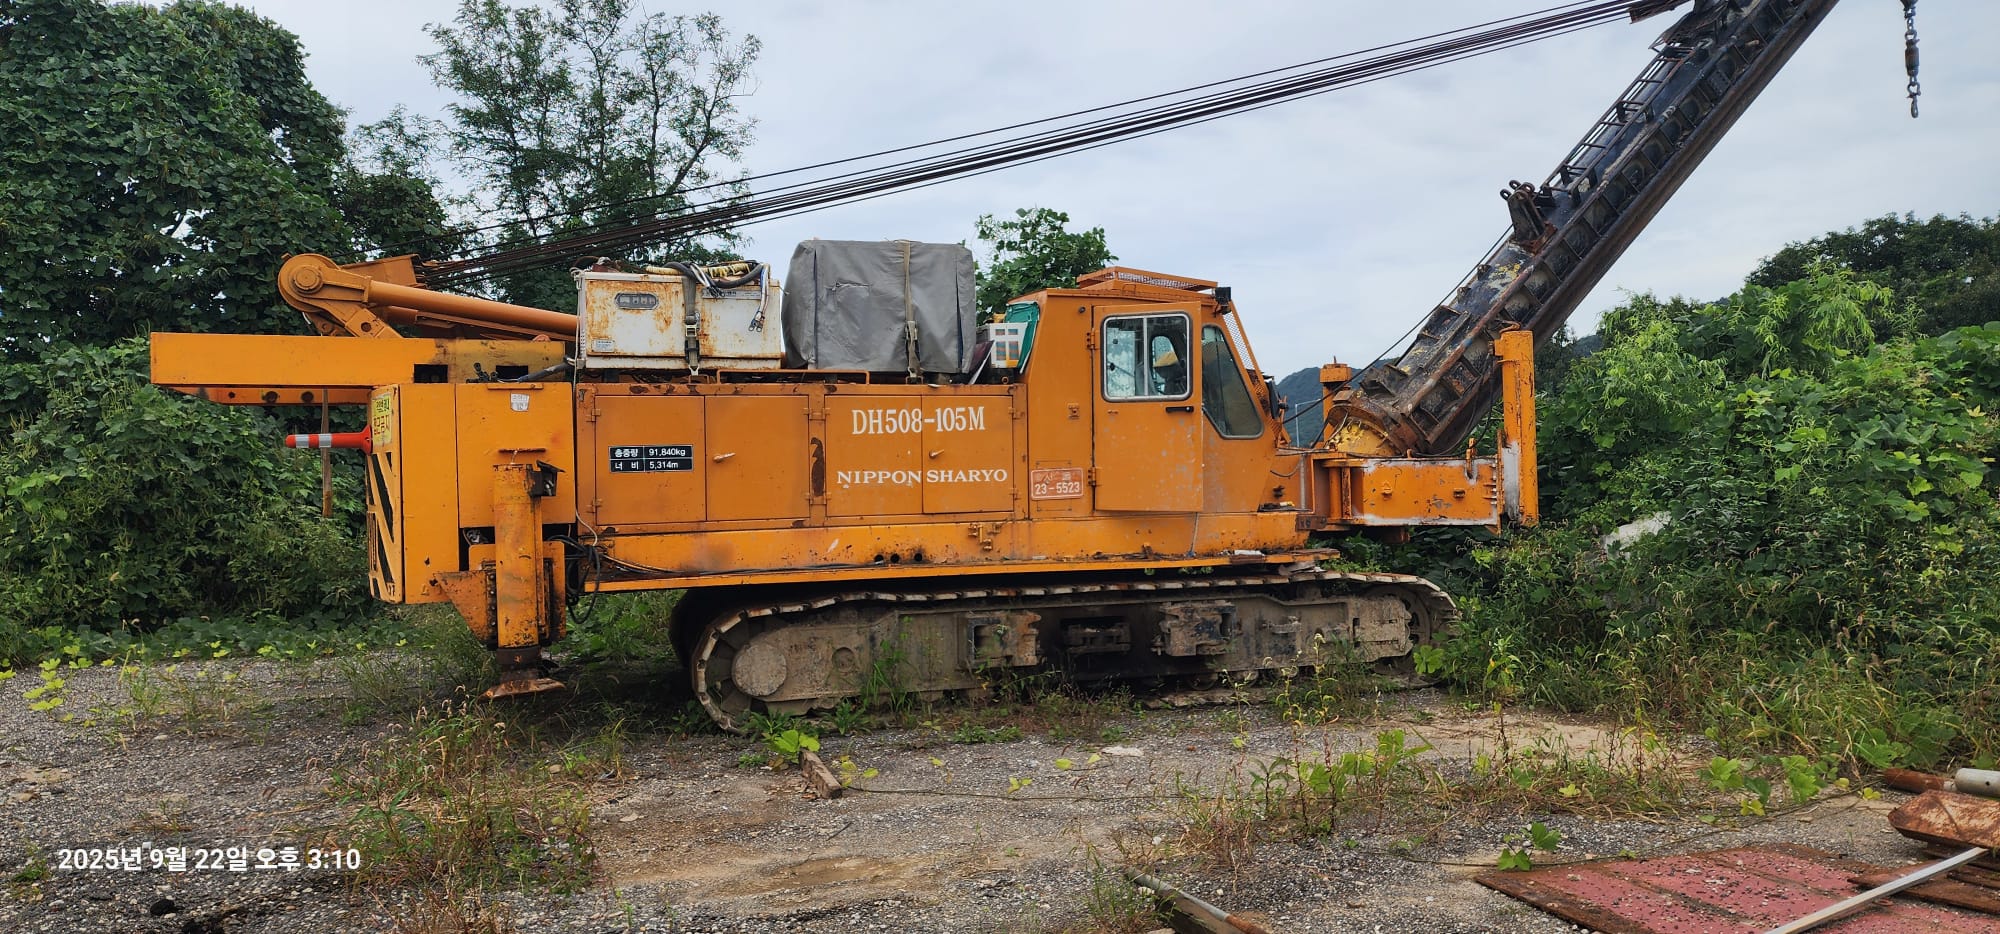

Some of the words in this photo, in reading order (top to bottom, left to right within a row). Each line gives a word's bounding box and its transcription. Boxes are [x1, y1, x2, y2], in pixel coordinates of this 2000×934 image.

[852, 406, 986, 435] DH508-105M
[648, 448, 686, 457] 91,840kg
[649, 461, 679, 470] 5,314m
[837, 470, 922, 484] NIPPON
[926, 469, 1008, 483] SHARYO
[1034, 481, 1080, 495] 23-5523
